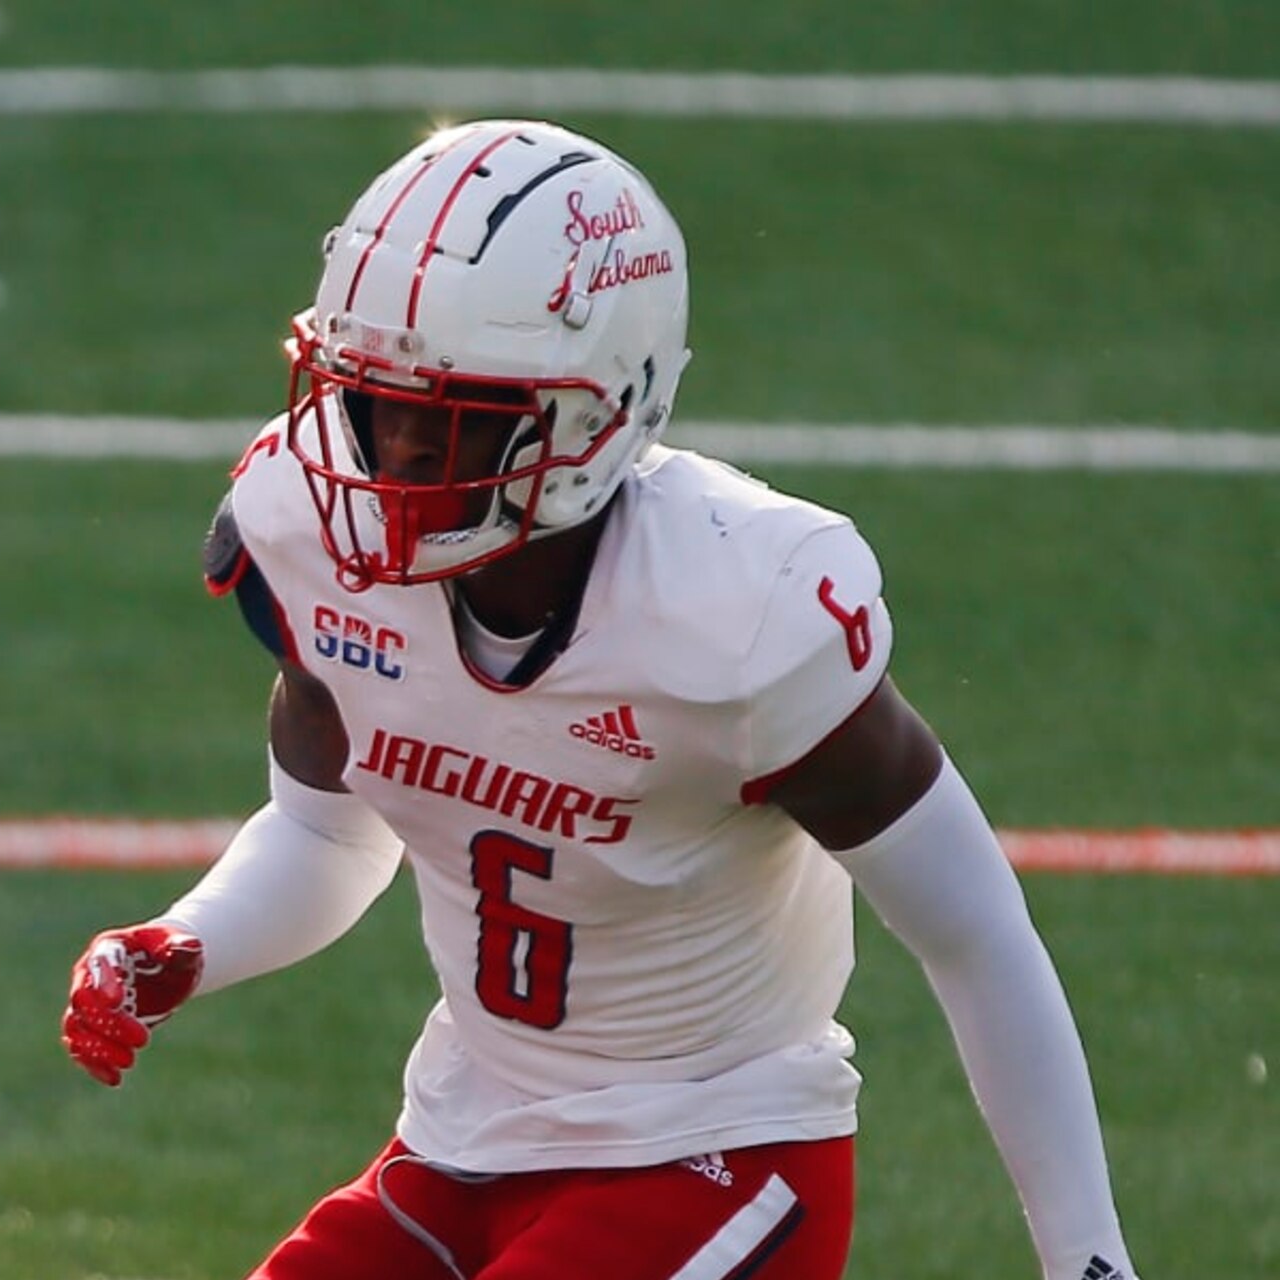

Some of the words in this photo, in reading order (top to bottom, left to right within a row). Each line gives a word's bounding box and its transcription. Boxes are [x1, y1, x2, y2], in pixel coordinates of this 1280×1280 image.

[563, 187, 646, 248] South
[313, 605, 406, 682] SBC
[817, 575, 872, 673] 6
[568, 722, 656, 761] adidas
[356, 728, 644, 844] JAGUARS
[468, 828, 574, 1031] 6
